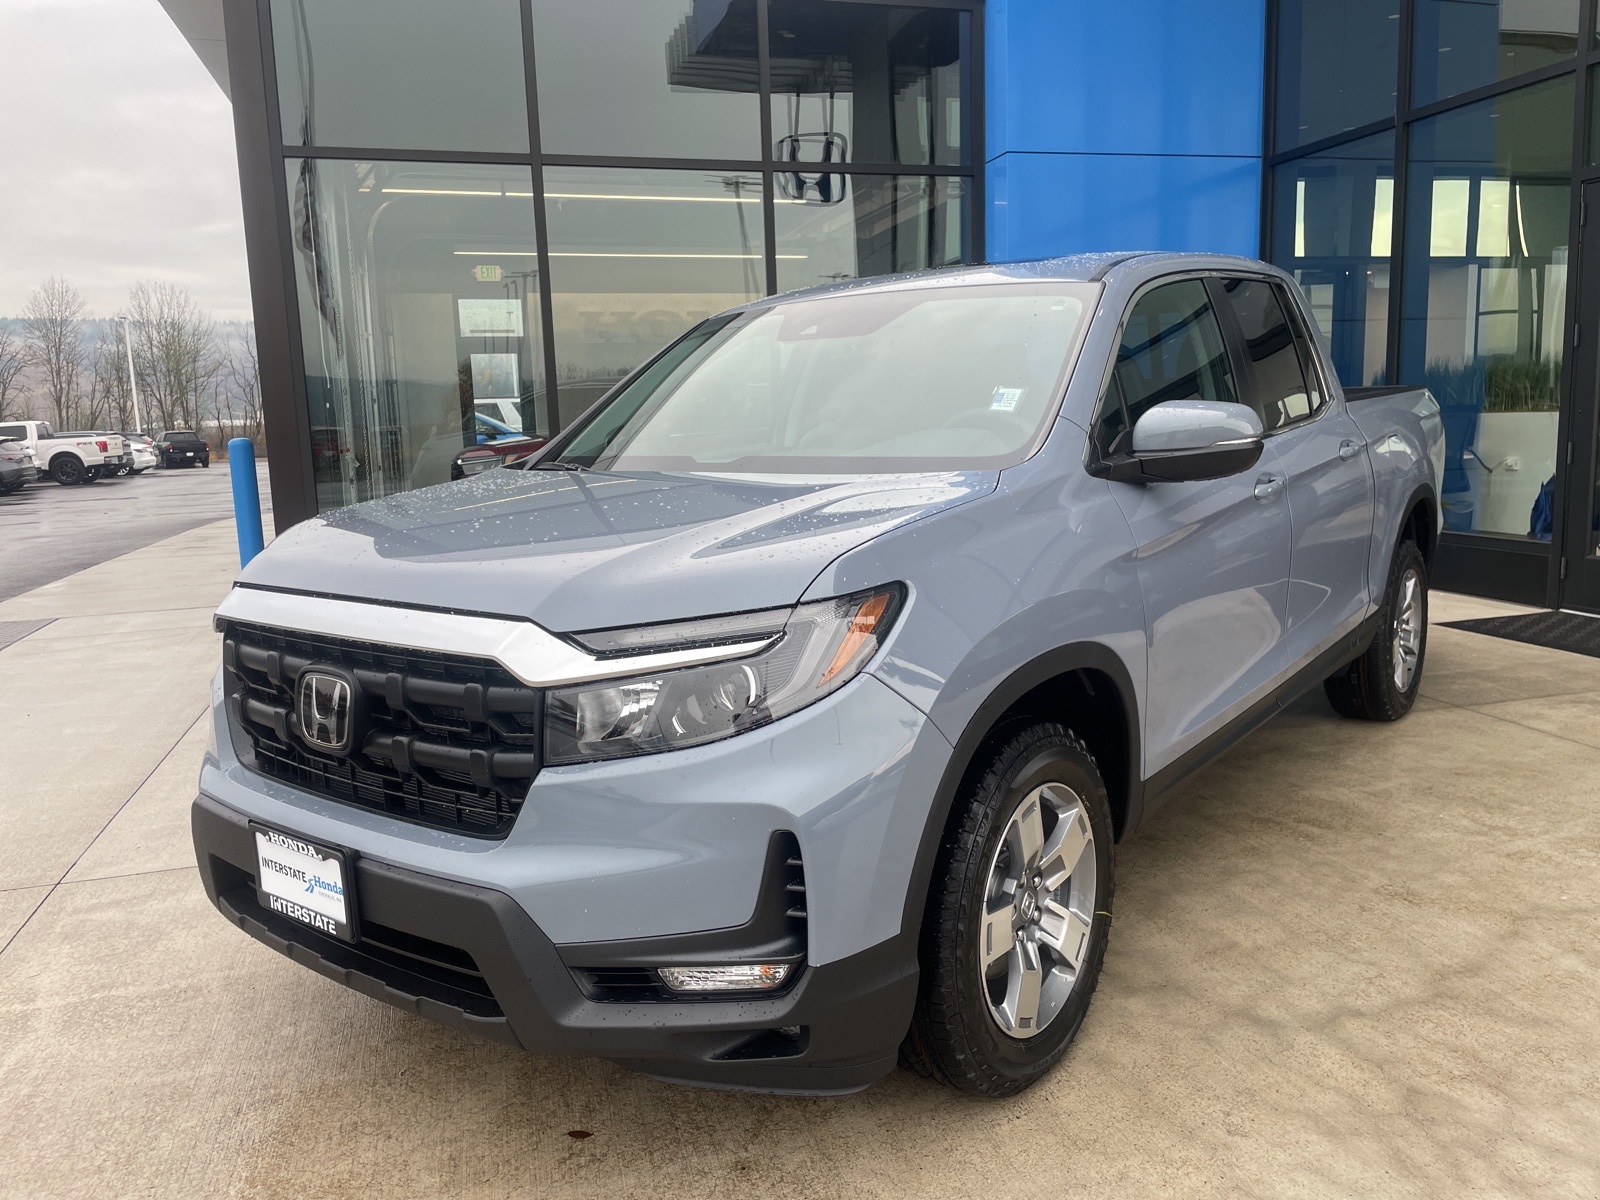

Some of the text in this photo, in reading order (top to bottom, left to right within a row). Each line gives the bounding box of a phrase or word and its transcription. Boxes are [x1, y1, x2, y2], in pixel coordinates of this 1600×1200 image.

[480, 266, 497, 279] EXIT
[268, 831, 318, 858] HONDA
[261, 856, 344, 896] INTERSTATE Honda
[269, 894, 337, 935] INTERSTATE
